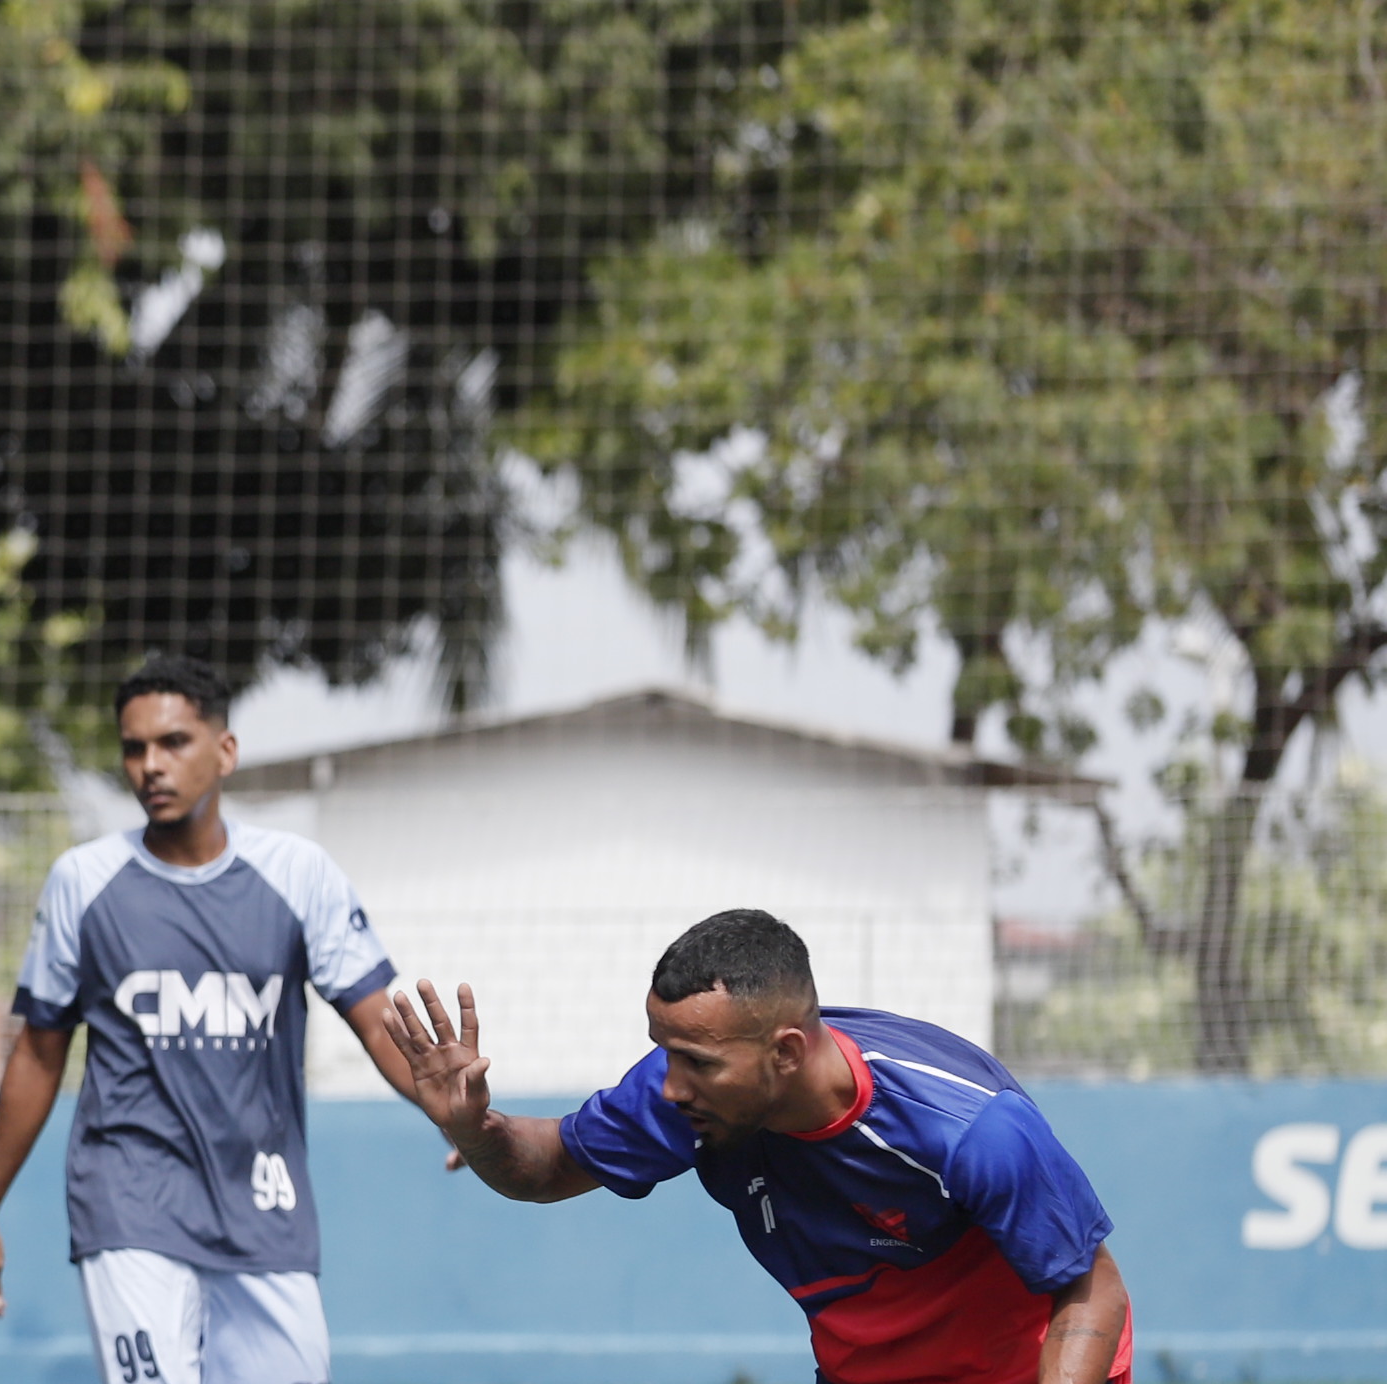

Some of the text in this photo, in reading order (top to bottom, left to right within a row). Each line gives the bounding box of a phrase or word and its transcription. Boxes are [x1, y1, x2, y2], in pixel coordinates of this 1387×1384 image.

[114, 969, 284, 1039] CMM
[251, 1151, 296, 1211] 99
[115, 1330, 159, 1384] 99
